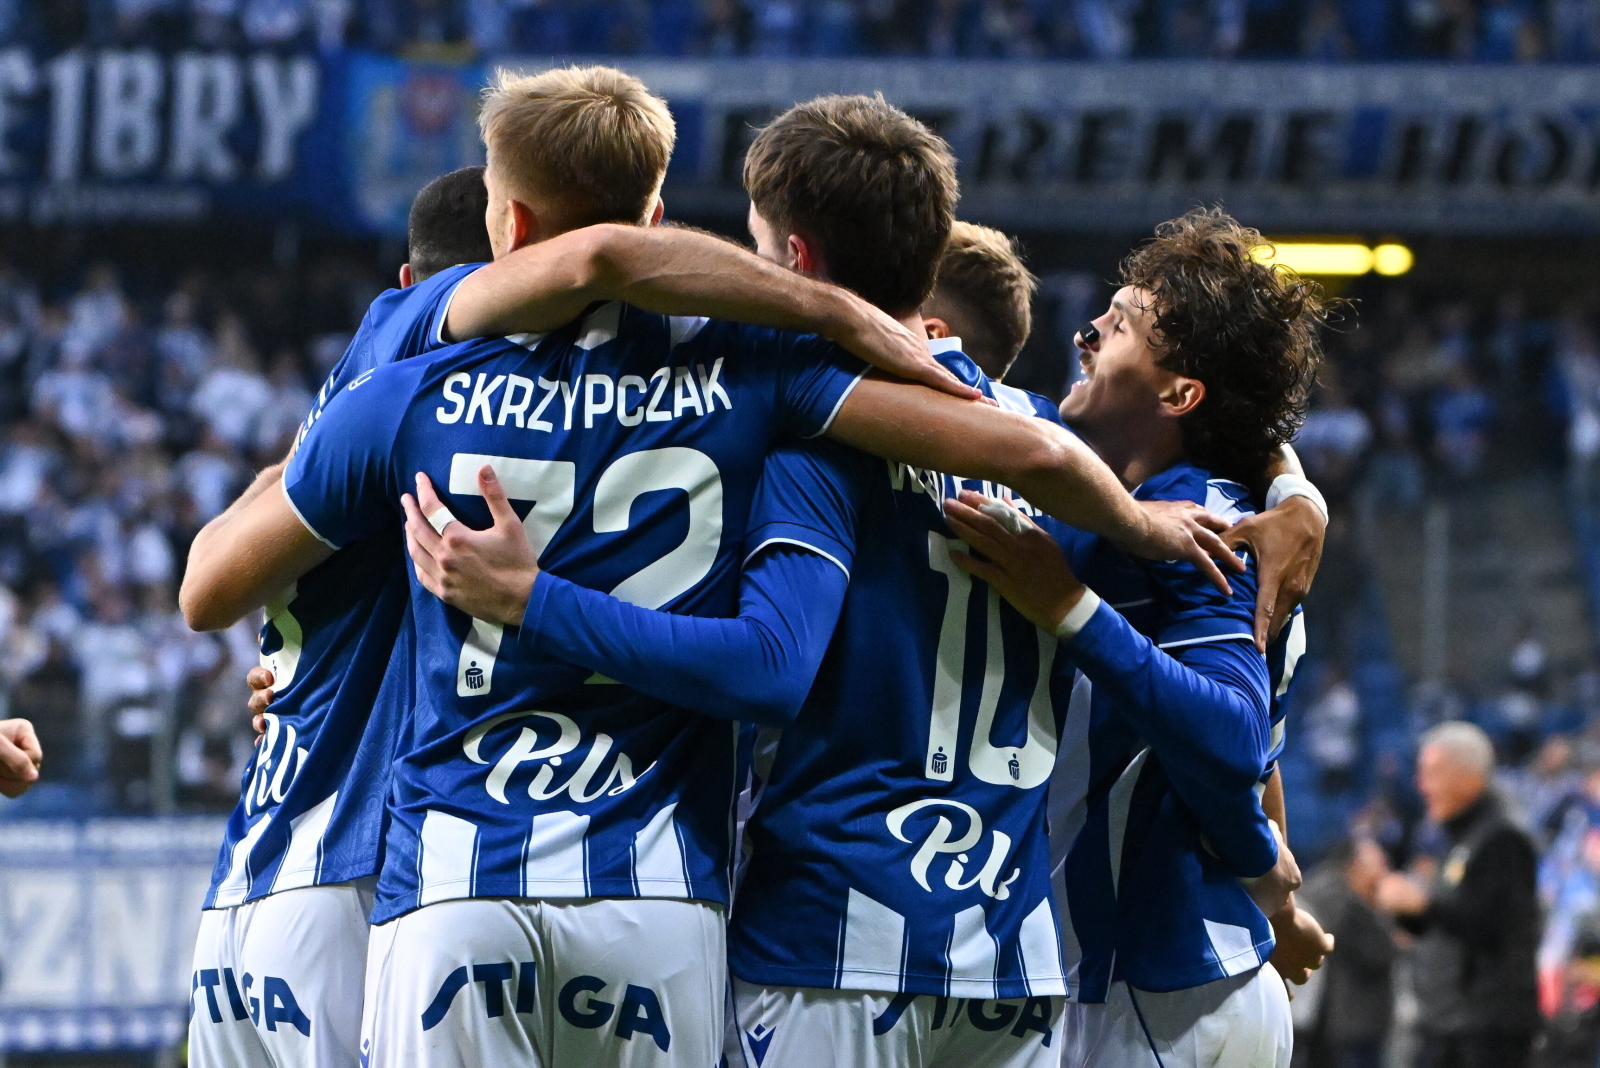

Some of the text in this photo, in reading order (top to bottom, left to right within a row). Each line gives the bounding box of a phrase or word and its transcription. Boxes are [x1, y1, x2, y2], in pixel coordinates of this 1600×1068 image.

[435, 357, 733, 433] SKRZYPCZAK
[449, 446, 723, 697] 72
[925, 530, 1058, 789] 10
[463, 710, 658, 804] Pils
[421, 961, 671, 1054] STIGA
